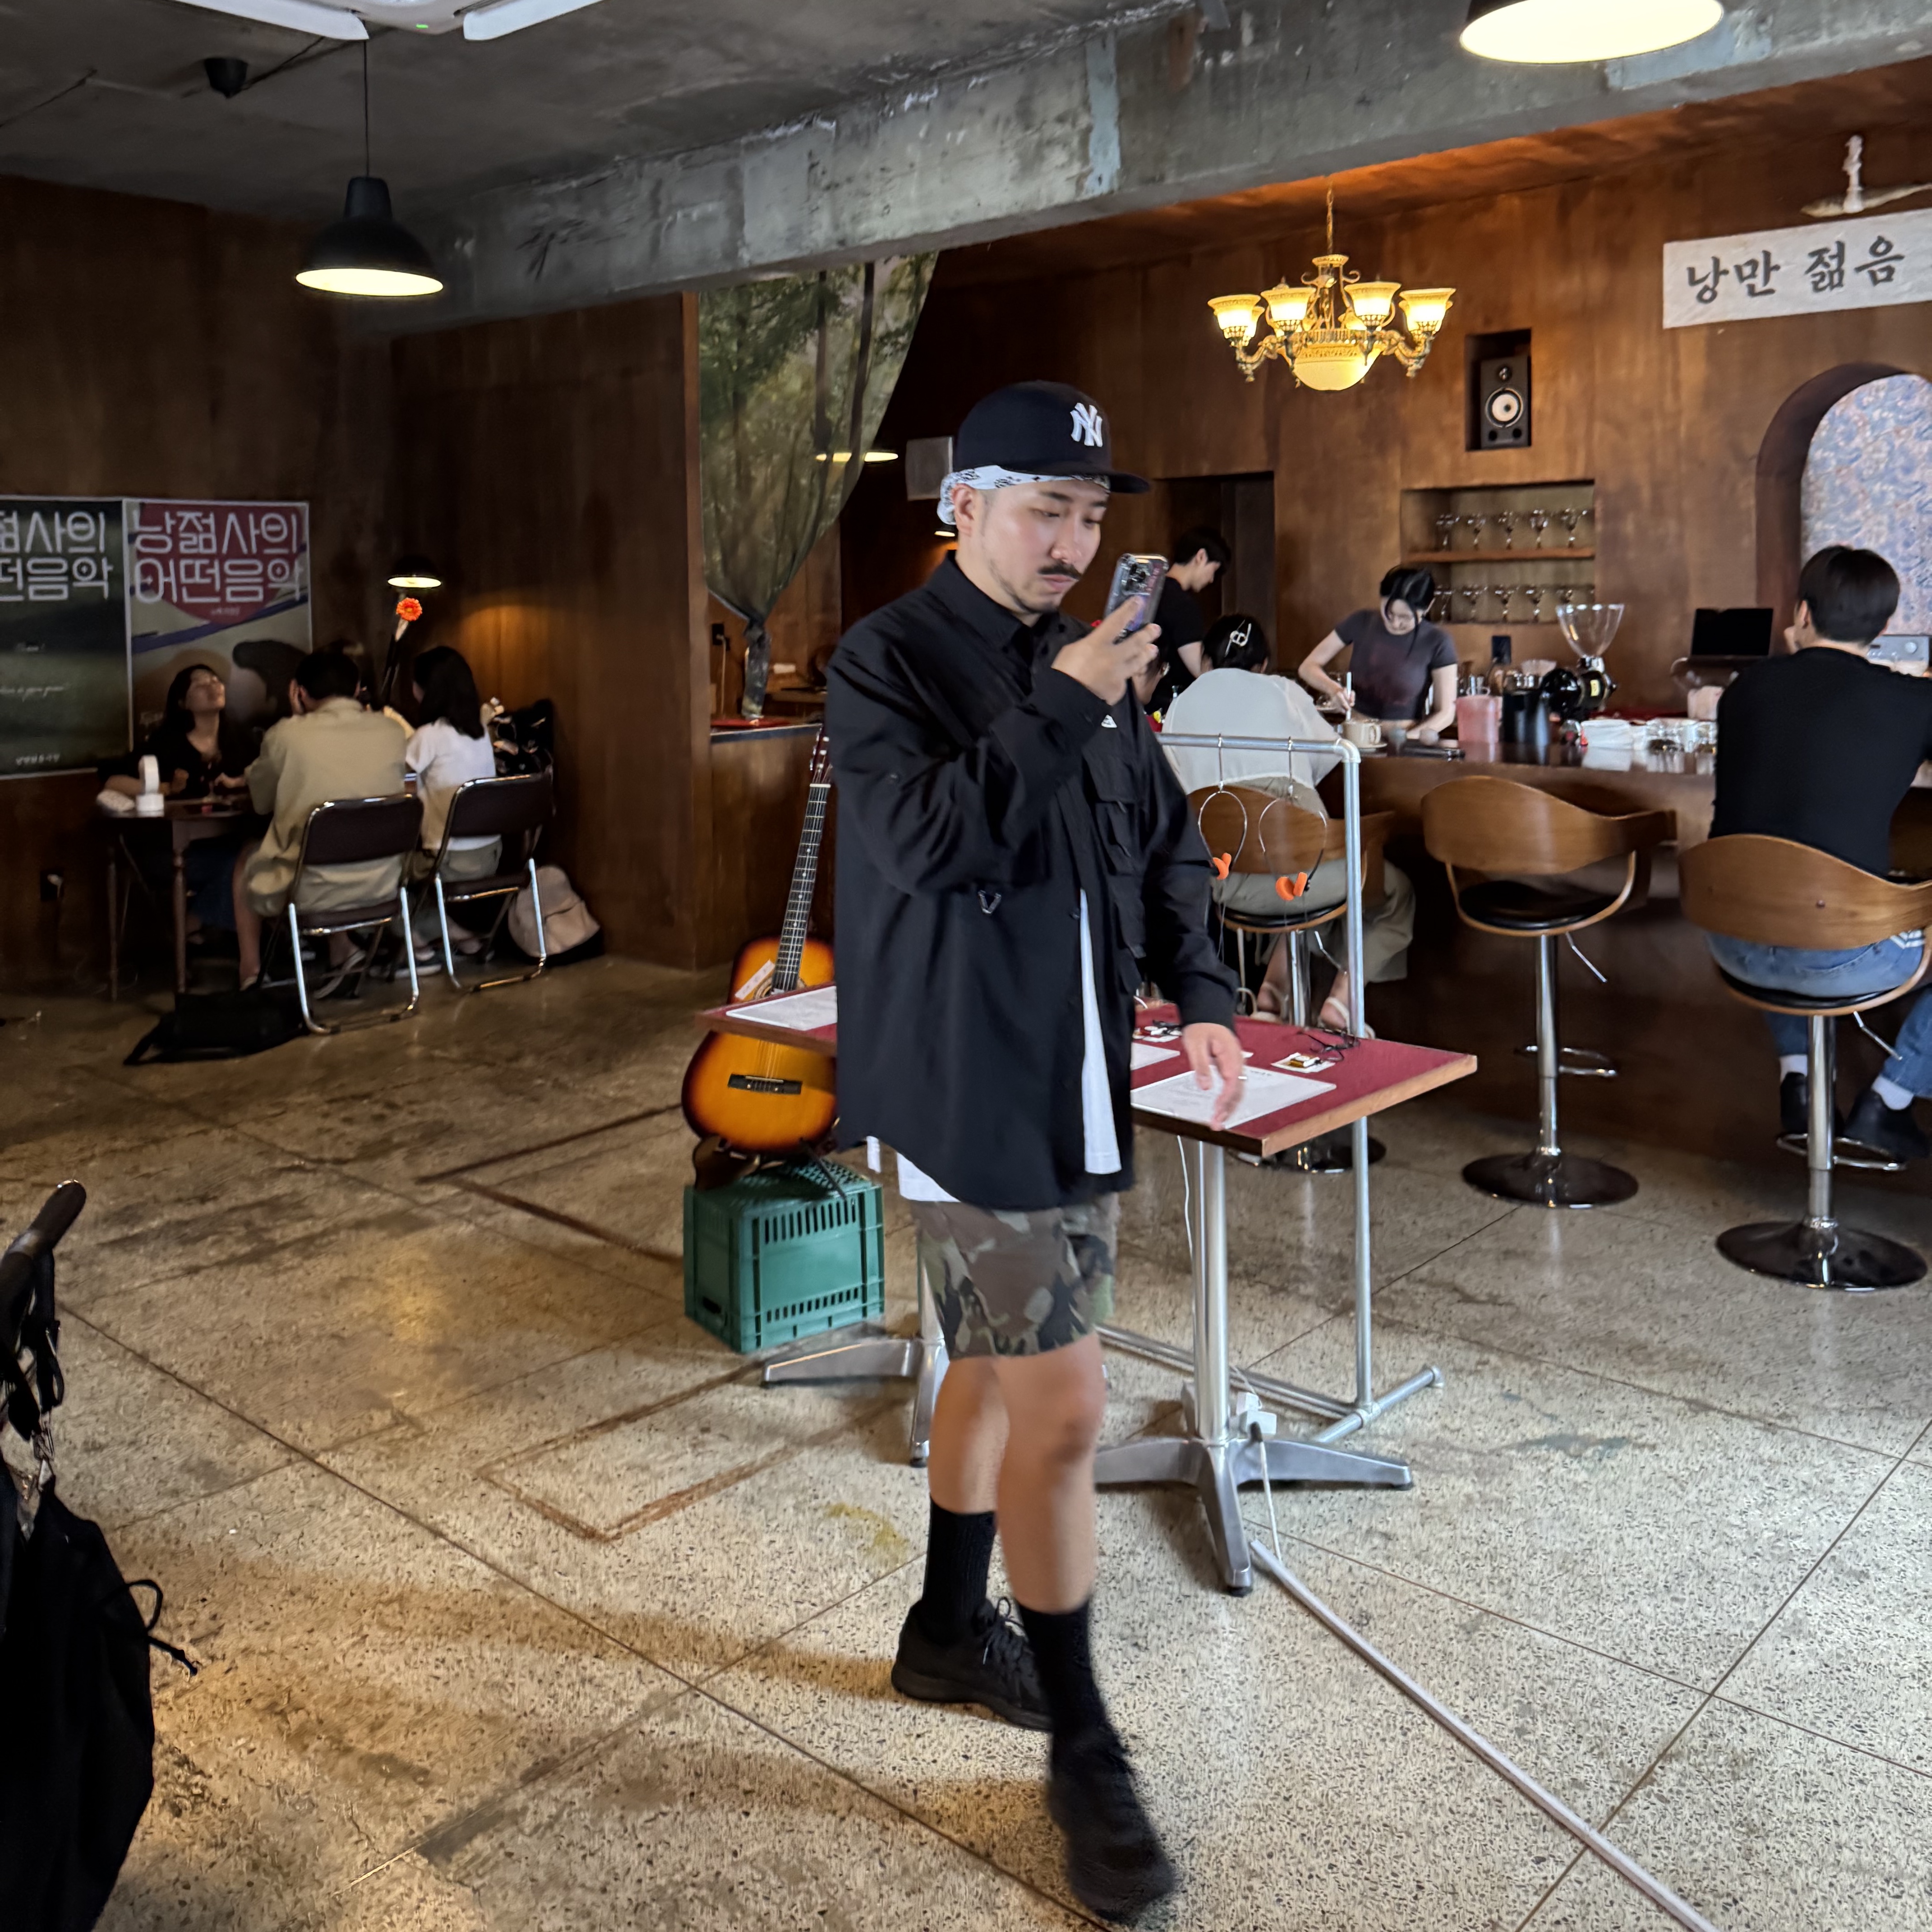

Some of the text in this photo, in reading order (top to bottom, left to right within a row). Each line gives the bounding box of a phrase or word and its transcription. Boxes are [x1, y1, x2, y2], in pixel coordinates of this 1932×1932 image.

[1687, 235, 1905, 305] 낭만 젊음
[1070, 402, 1103, 448] NY
[133, 510, 297, 554] 낭젊사의
